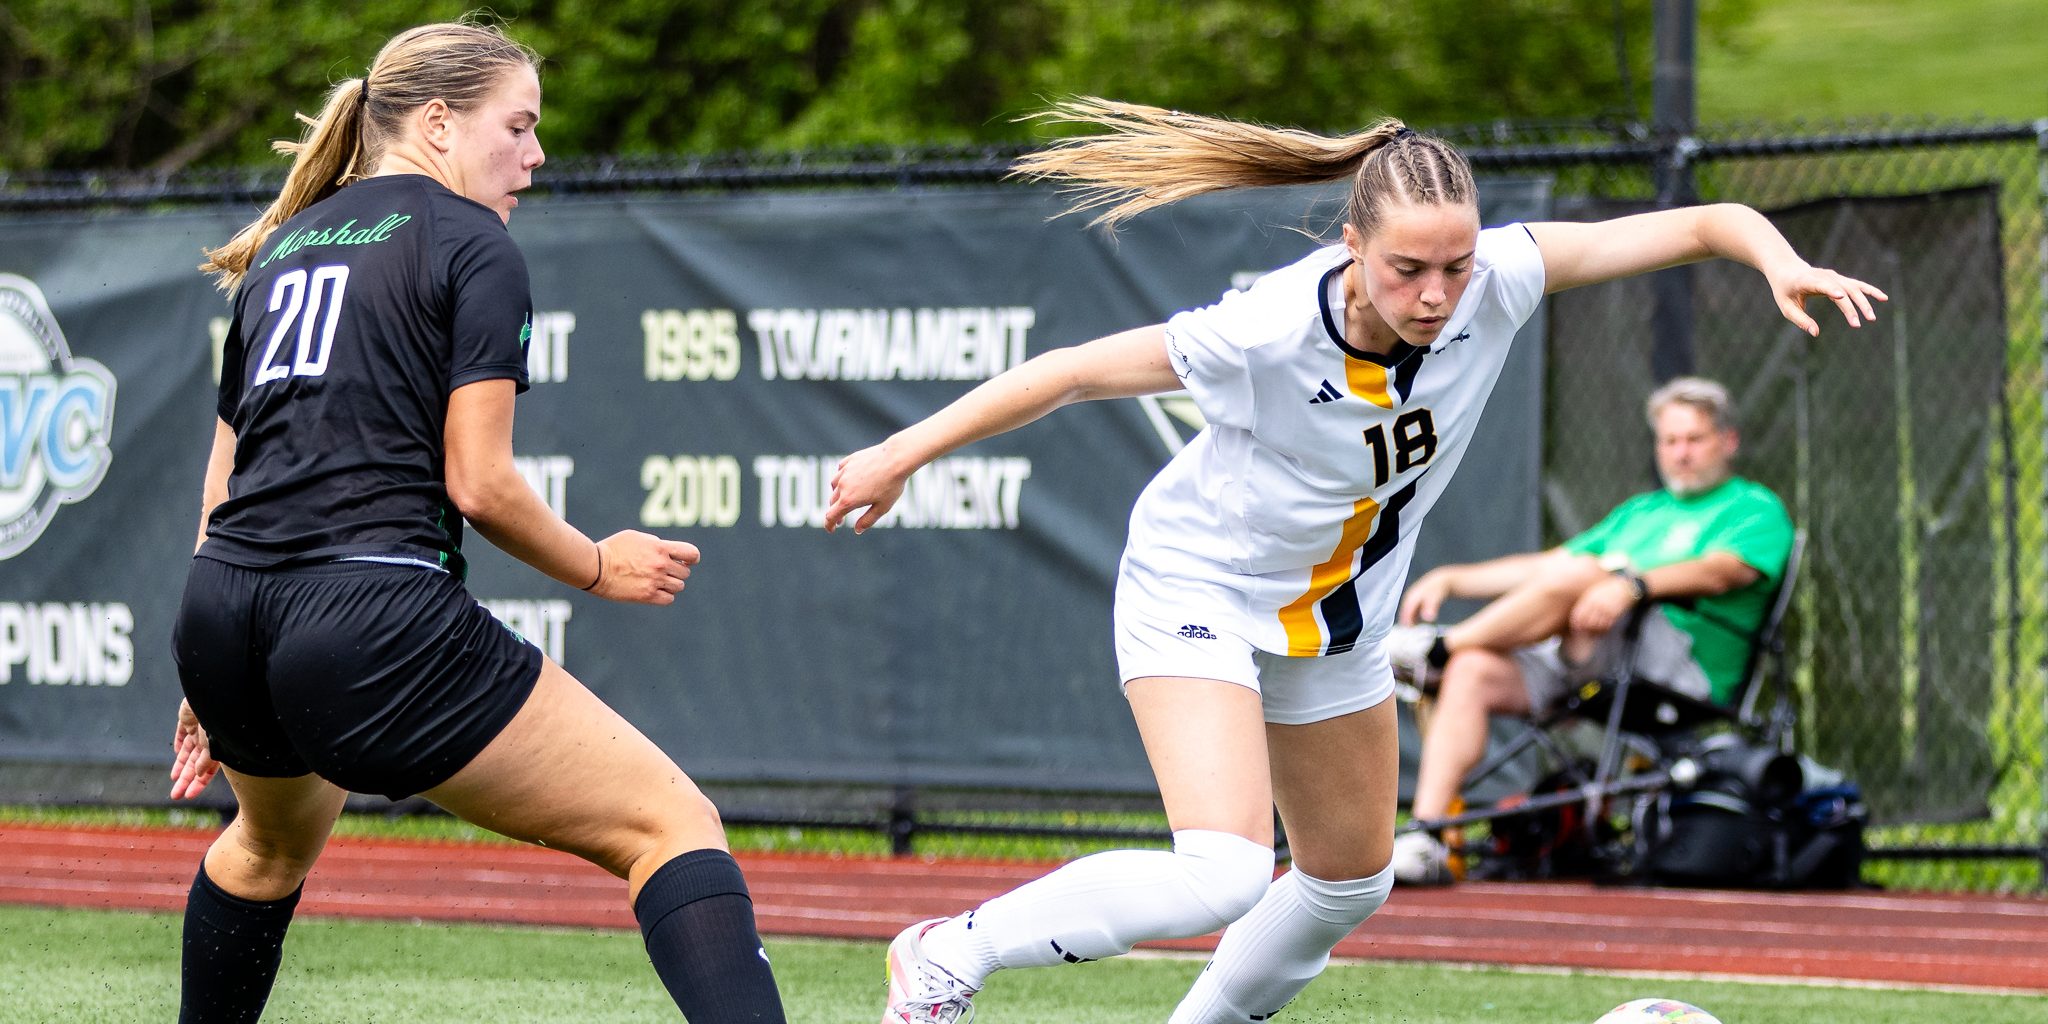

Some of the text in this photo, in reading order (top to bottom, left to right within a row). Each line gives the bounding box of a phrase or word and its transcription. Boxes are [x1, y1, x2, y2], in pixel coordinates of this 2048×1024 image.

[259, 213, 412, 269] Marshall
[254, 264, 350, 387] 20
[640, 308, 742, 381] 1995
[748, 307, 1036, 381] TOURNAMENT
[1362, 407, 1439, 489] 18
[640, 455, 742, 528] 2010
[753, 455, 1032, 529] TOUAMENT
